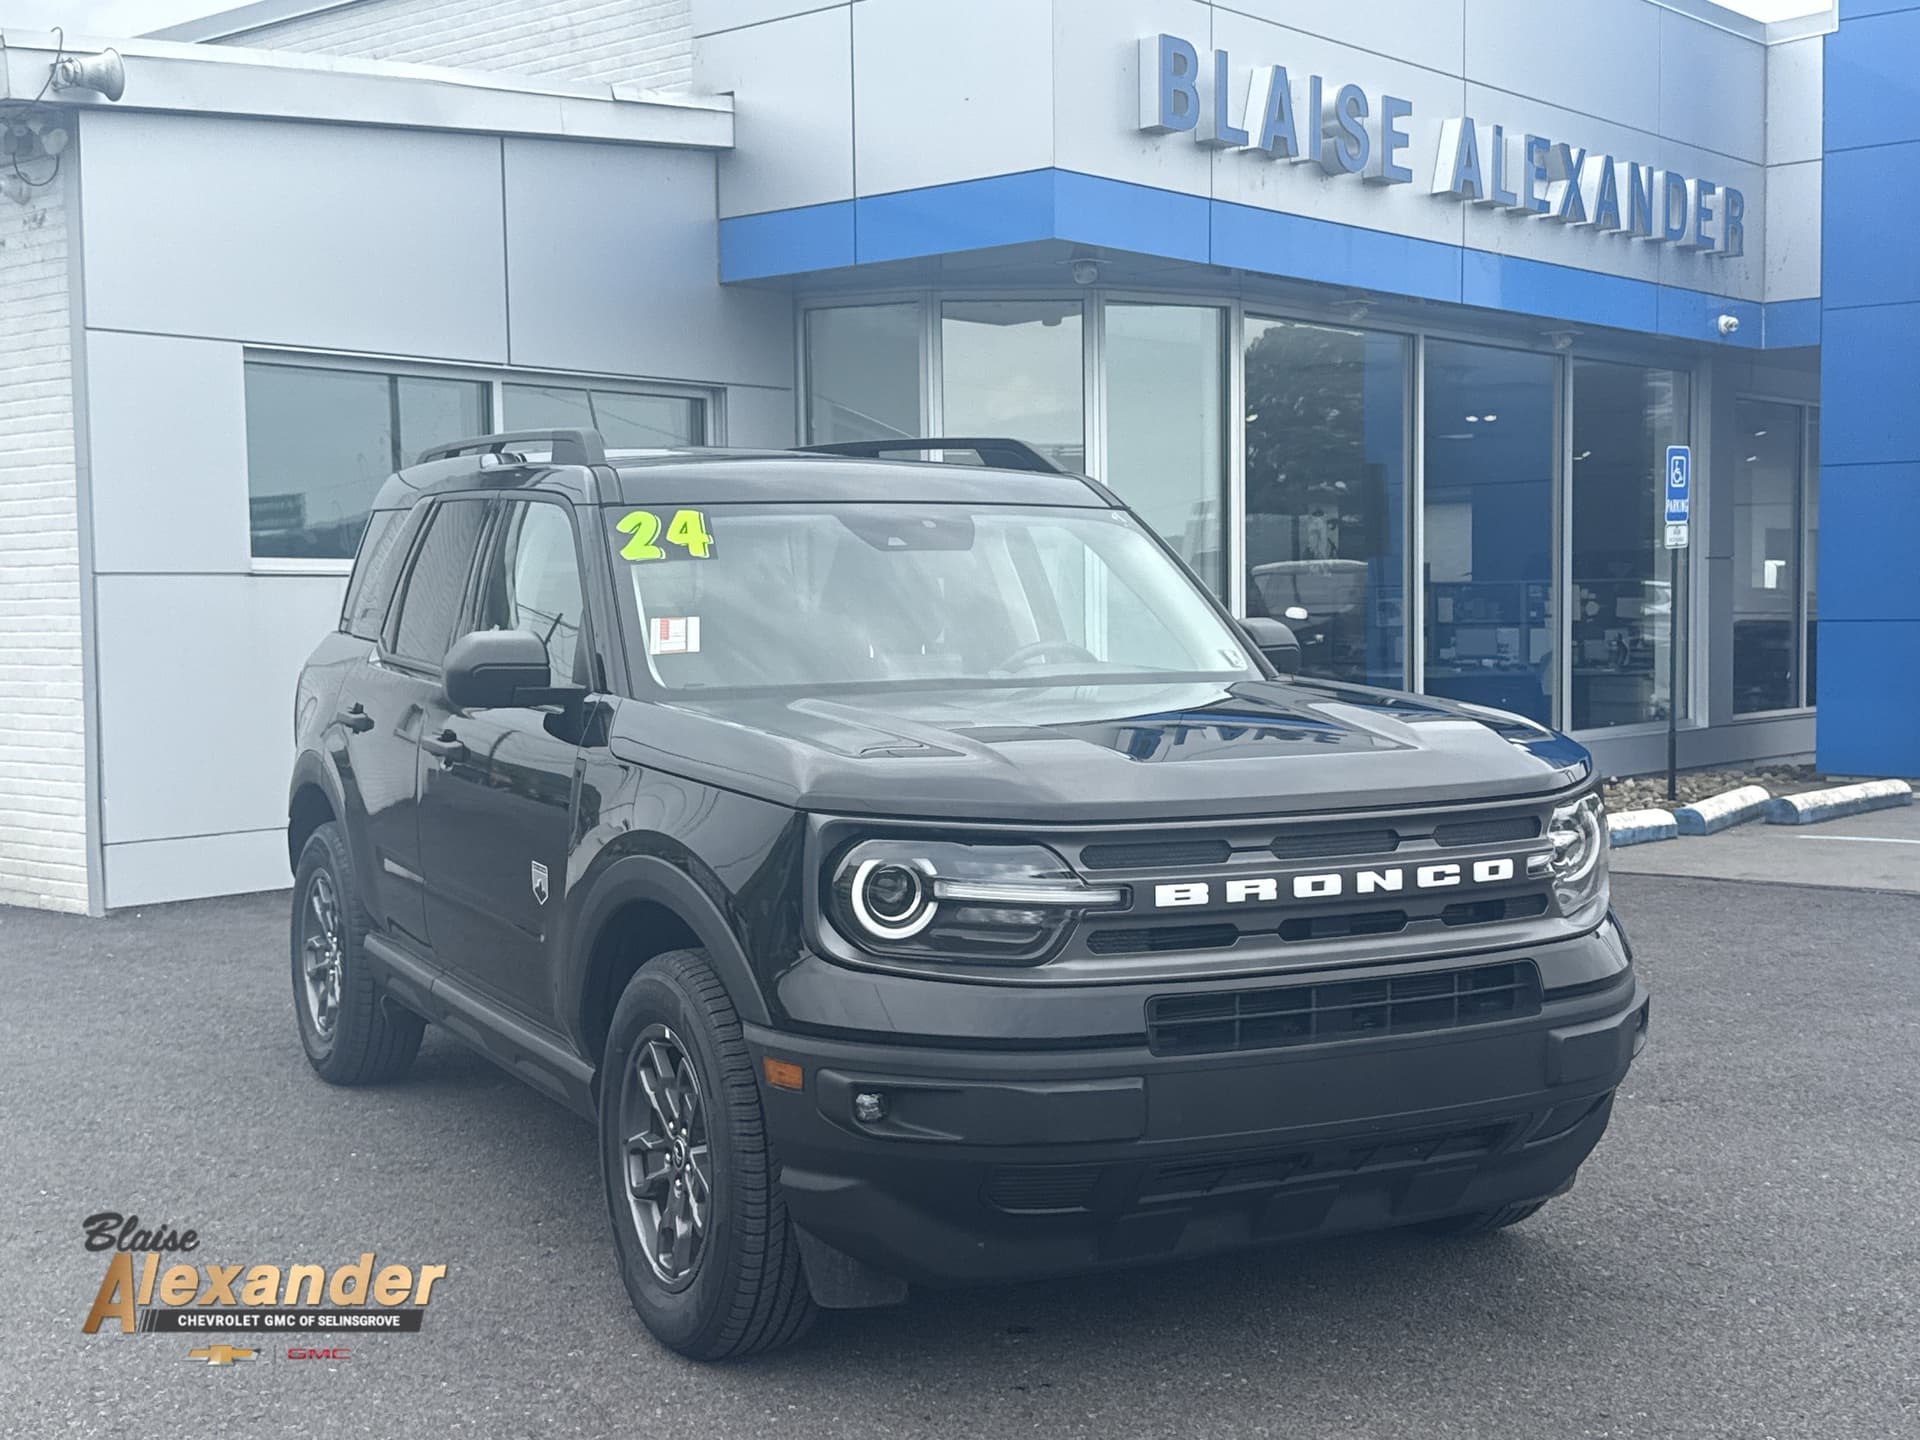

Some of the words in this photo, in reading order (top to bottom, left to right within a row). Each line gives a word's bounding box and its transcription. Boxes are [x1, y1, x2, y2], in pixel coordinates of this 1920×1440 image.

[1139, 33, 1413, 185] BLAISE
[1432, 116, 1746, 258] ALEXANDER
[1667, 499, 1688, 513] PARKING
[615, 509, 714, 562] 24
[1154, 858, 1514, 908] BRONCO
